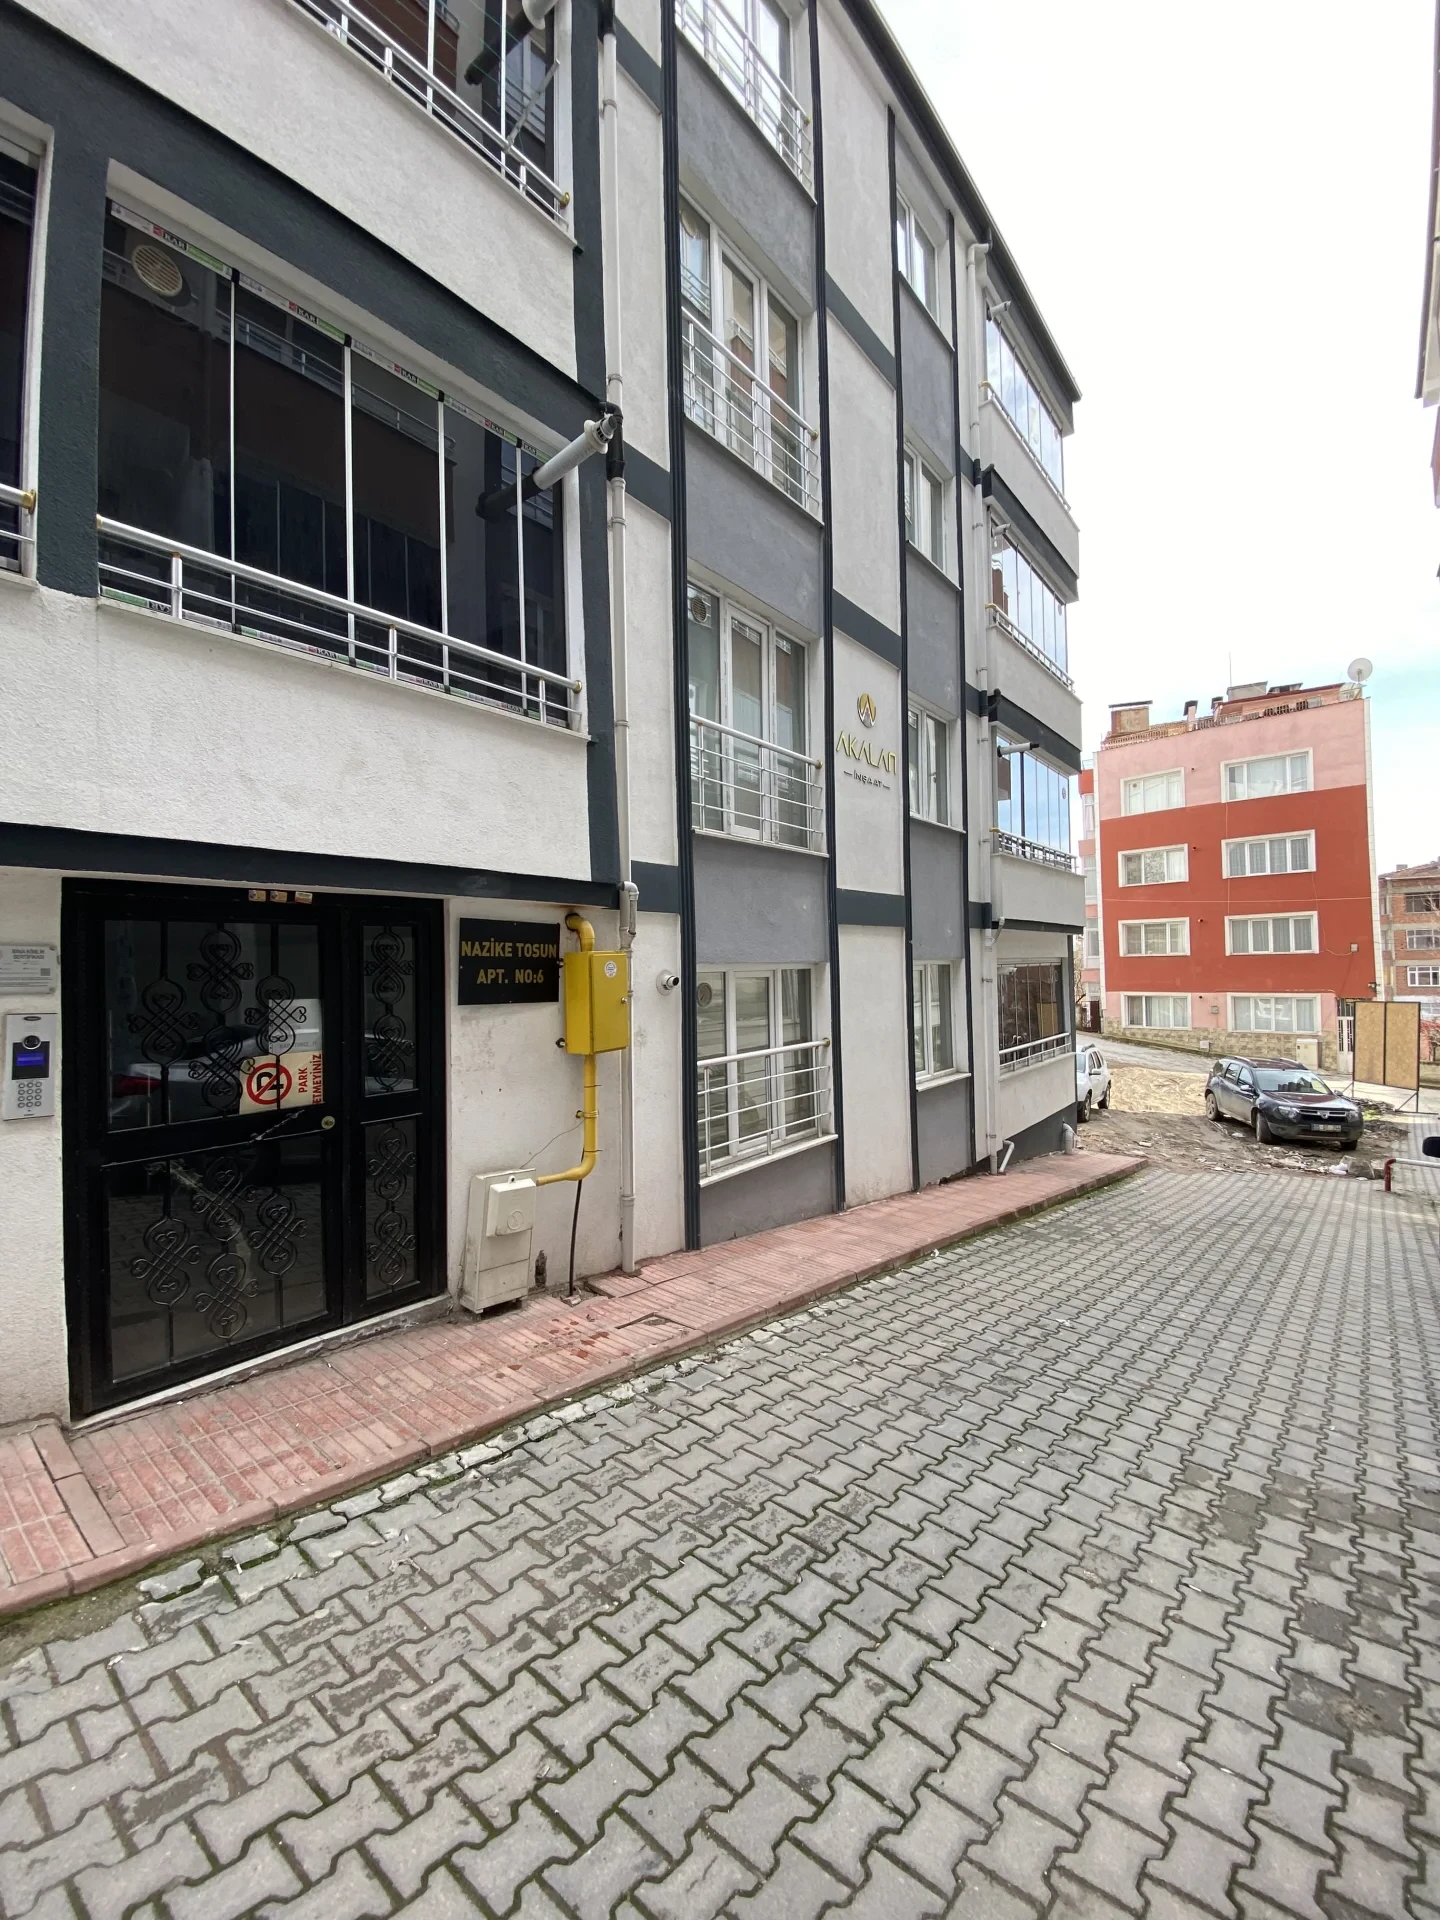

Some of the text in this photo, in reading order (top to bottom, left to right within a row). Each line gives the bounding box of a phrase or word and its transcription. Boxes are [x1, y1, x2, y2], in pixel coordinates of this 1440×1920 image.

[836, 730, 897, 775] AKALAN
[461, 938, 557, 958] NAZİKE TOSUN
[476, 968, 544, 985] APT. NO:6
[298, 1067, 308, 1093] PARK
[310, 1053, 322, 1104] ETMEYİNİZ
